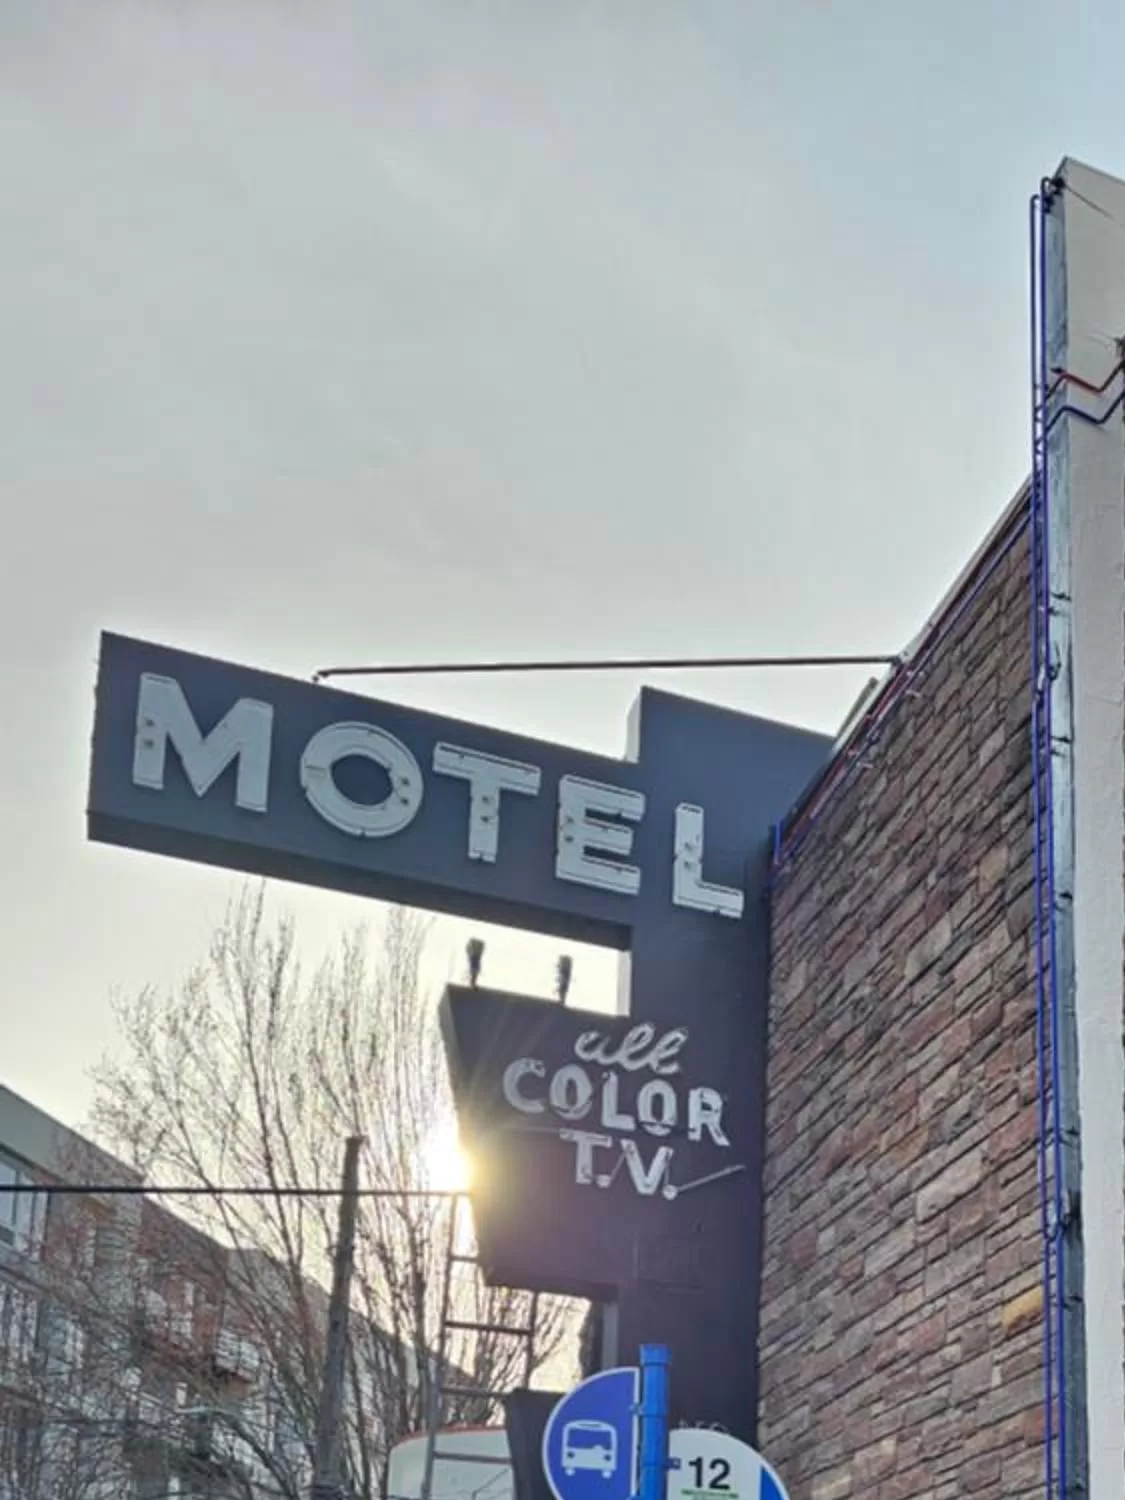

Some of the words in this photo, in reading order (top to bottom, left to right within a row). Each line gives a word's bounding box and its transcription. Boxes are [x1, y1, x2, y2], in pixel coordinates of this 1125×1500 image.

[132, 671, 744, 919] MOTEL
[574, 1022, 688, 1075] all
[502, 1056, 731, 1147] COLOR
[559, 1127, 679, 1201] T.V.
[688, 1456, 731, 1490] 12
